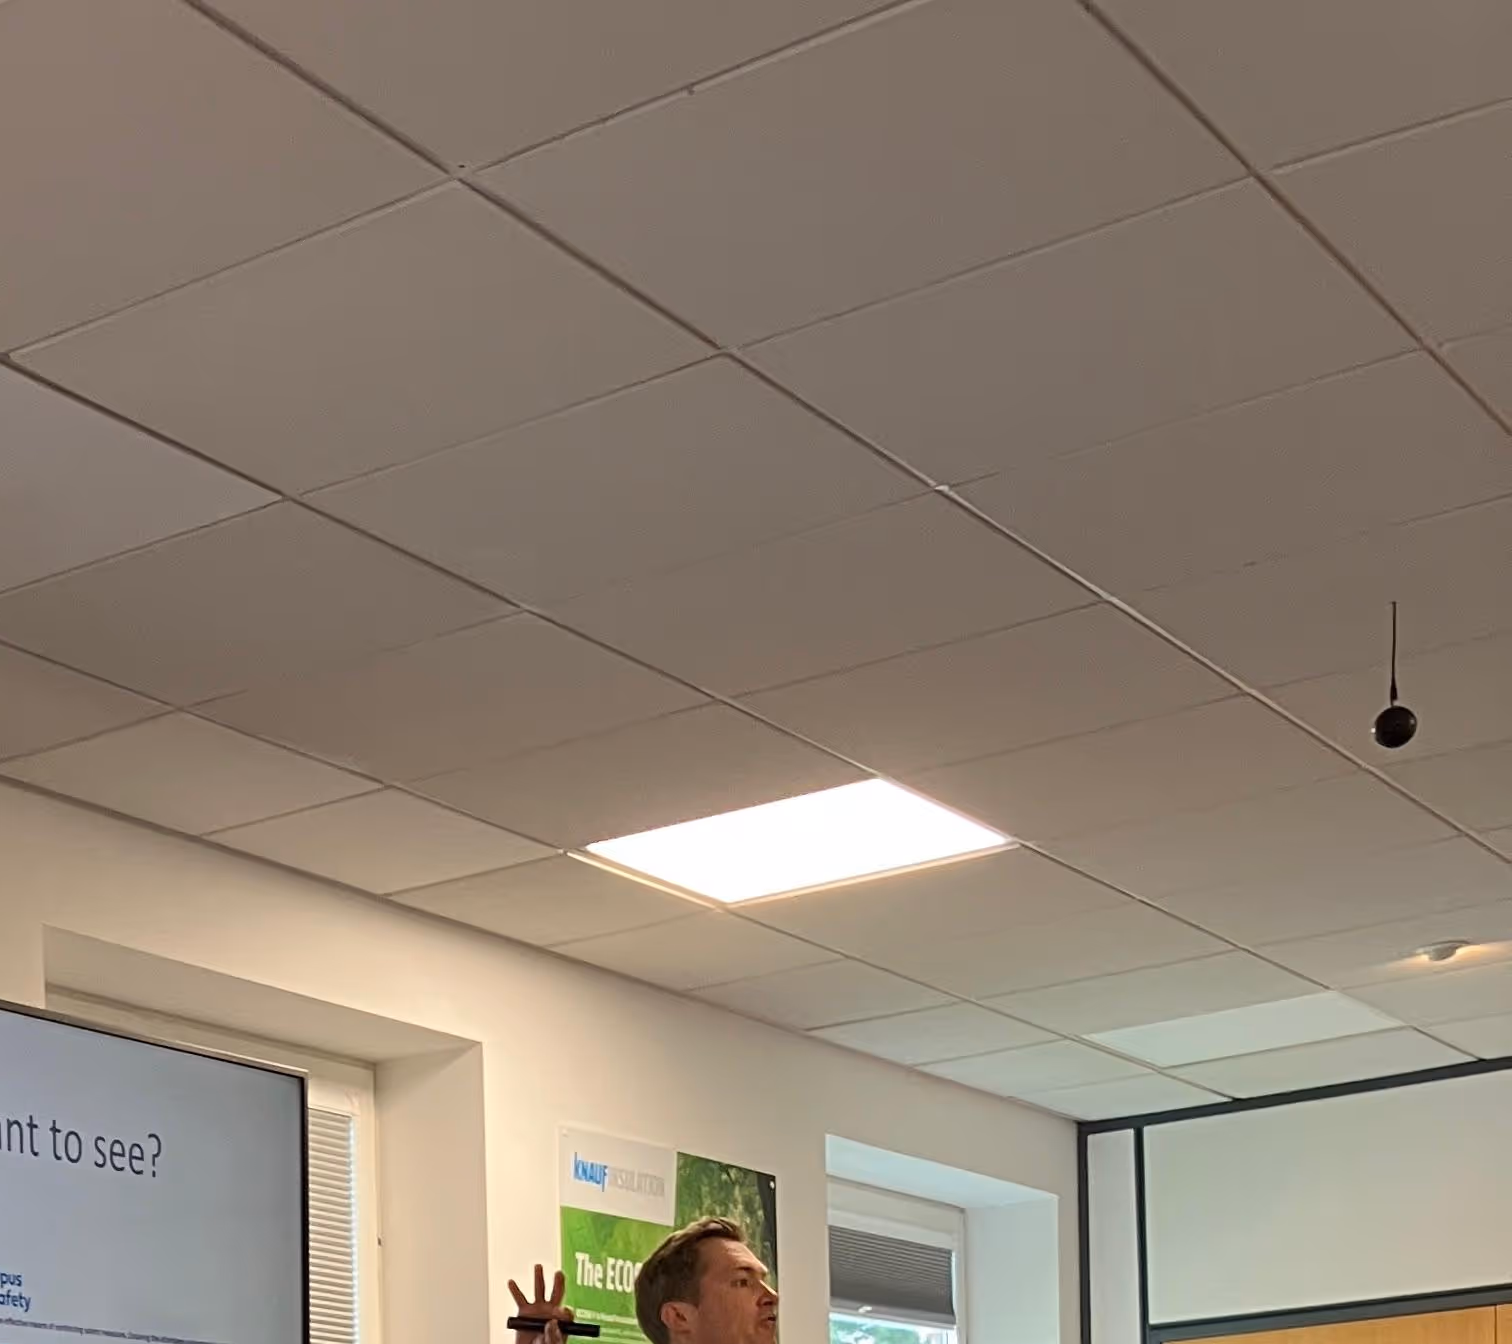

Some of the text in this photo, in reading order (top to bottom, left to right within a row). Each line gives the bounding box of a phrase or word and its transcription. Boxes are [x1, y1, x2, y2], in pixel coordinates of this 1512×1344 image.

[49, 1120, 82, 1163] to
[94, 1134, 161, 1177] see?
[575, 1251, 603, 1290] The
